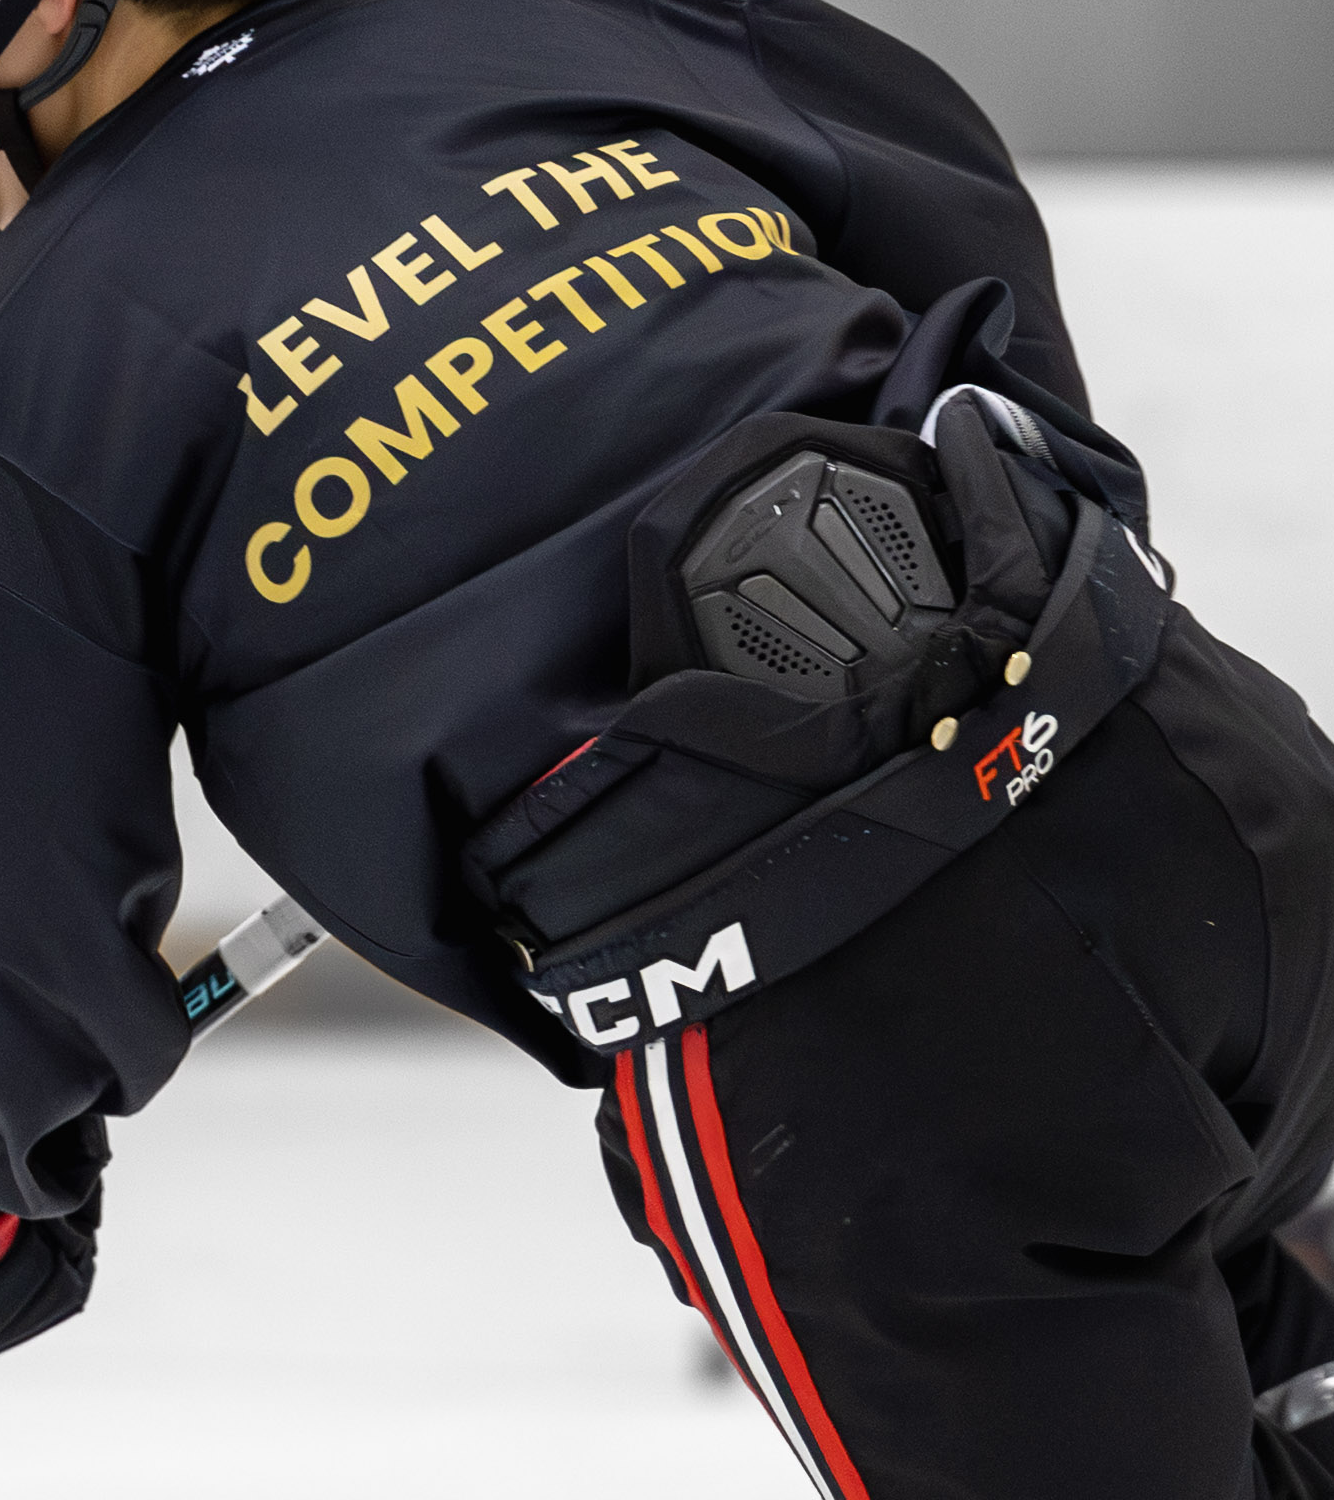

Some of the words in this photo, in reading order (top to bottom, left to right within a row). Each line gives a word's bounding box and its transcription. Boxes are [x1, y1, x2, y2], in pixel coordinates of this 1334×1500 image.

[237, 215, 504, 437] LEVEL
[481, 139, 681, 231] THE
[244, 206, 801, 604] COMPETITION
[973, 711, 1059, 802] FT6
[1005, 748, 1054, 806] PRO
